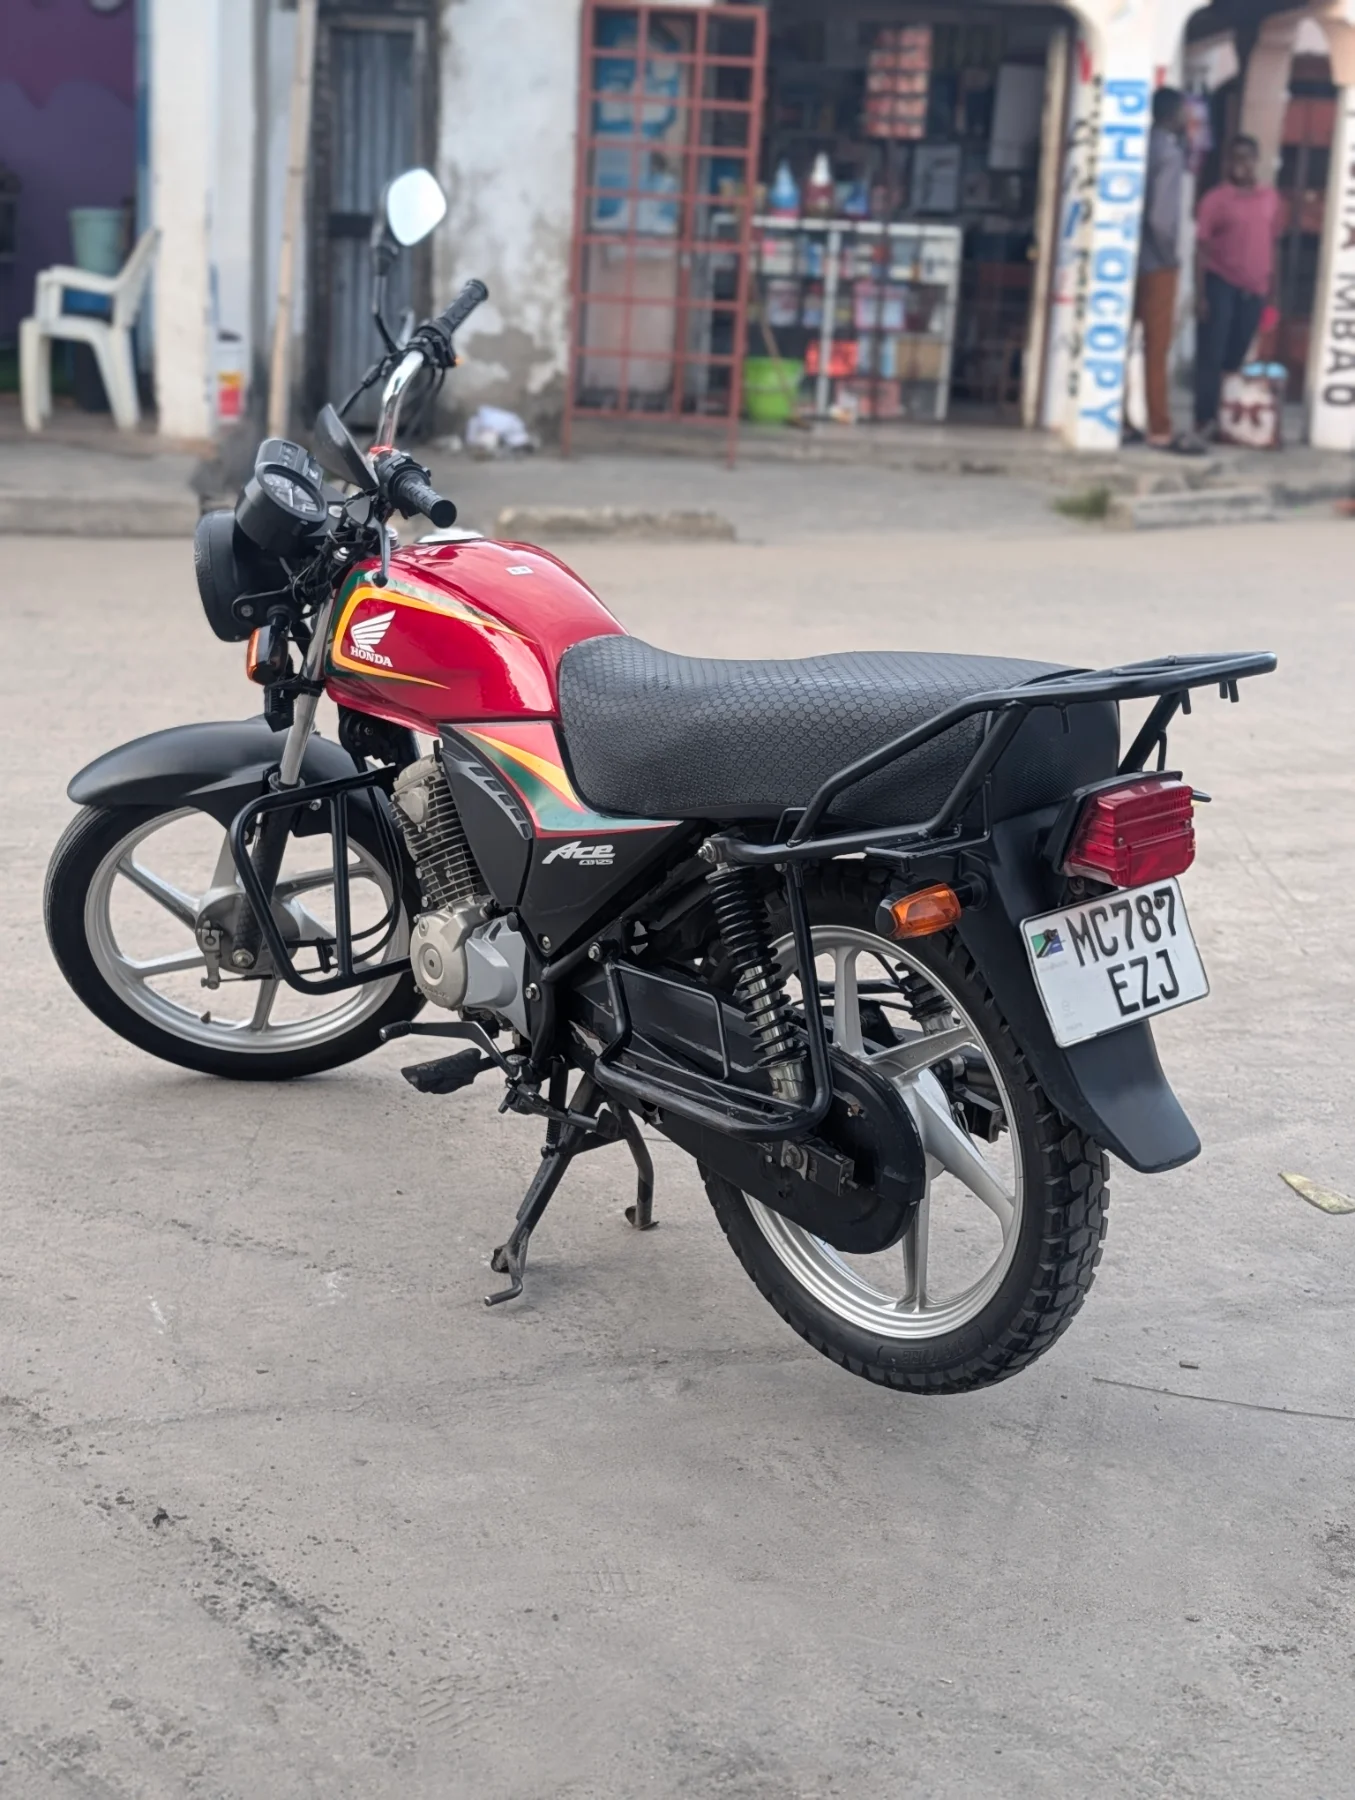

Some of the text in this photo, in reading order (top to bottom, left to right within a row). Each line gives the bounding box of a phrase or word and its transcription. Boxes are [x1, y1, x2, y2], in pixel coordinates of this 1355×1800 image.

[1079, 80, 1147, 432] PHOTOCOPY
[350, 645, 394, 668] HONDA
[1065, 886, 1177, 967] MC787
[1106, 948, 1180, 1016] EZJ
